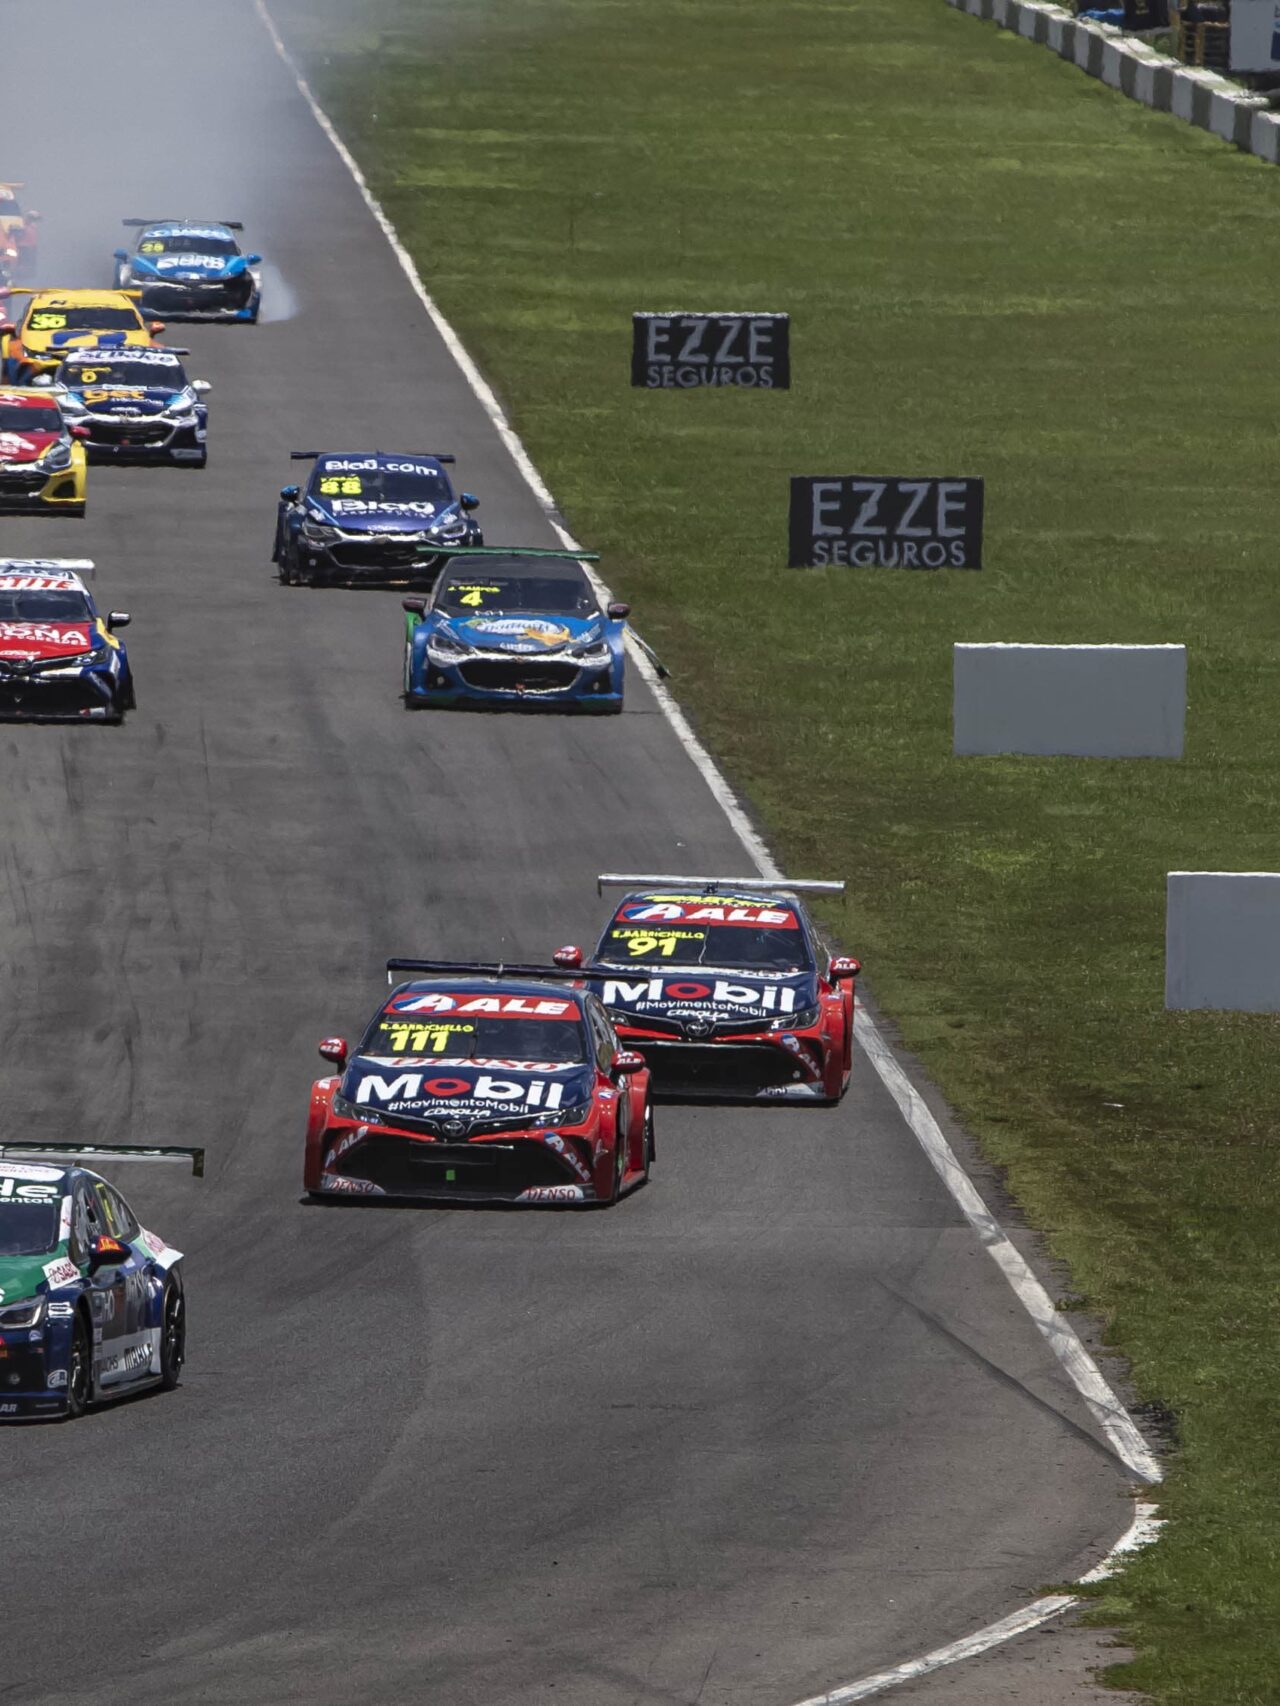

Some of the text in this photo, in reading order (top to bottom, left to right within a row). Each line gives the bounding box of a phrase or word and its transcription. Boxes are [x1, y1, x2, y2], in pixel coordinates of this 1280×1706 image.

[647, 319, 774, 363] EZZE
[646, 366, 774, 389] SEGUROS
[320, 480, 362, 494] 88
[811, 482, 967, 537] EZZE
[811, 541, 966, 566] SEGUROS
[460, 591, 483, 606] 4
[685, 907, 790, 924] ALE
[626, 937, 677, 956] 91
[602, 978, 796, 1013] Mobil
[457, 997, 570, 1015] ALE
[636, 999, 767, 1018] #MovimentoMobil
[389, 1030, 450, 1053] 111
[391, 1056, 560, 1071] DENSO
[355, 1073, 565, 1109] Mobil
[387, 1098, 529, 1114] #MovimentoMobil
[527, 1187, 577, 1201] DENSO
